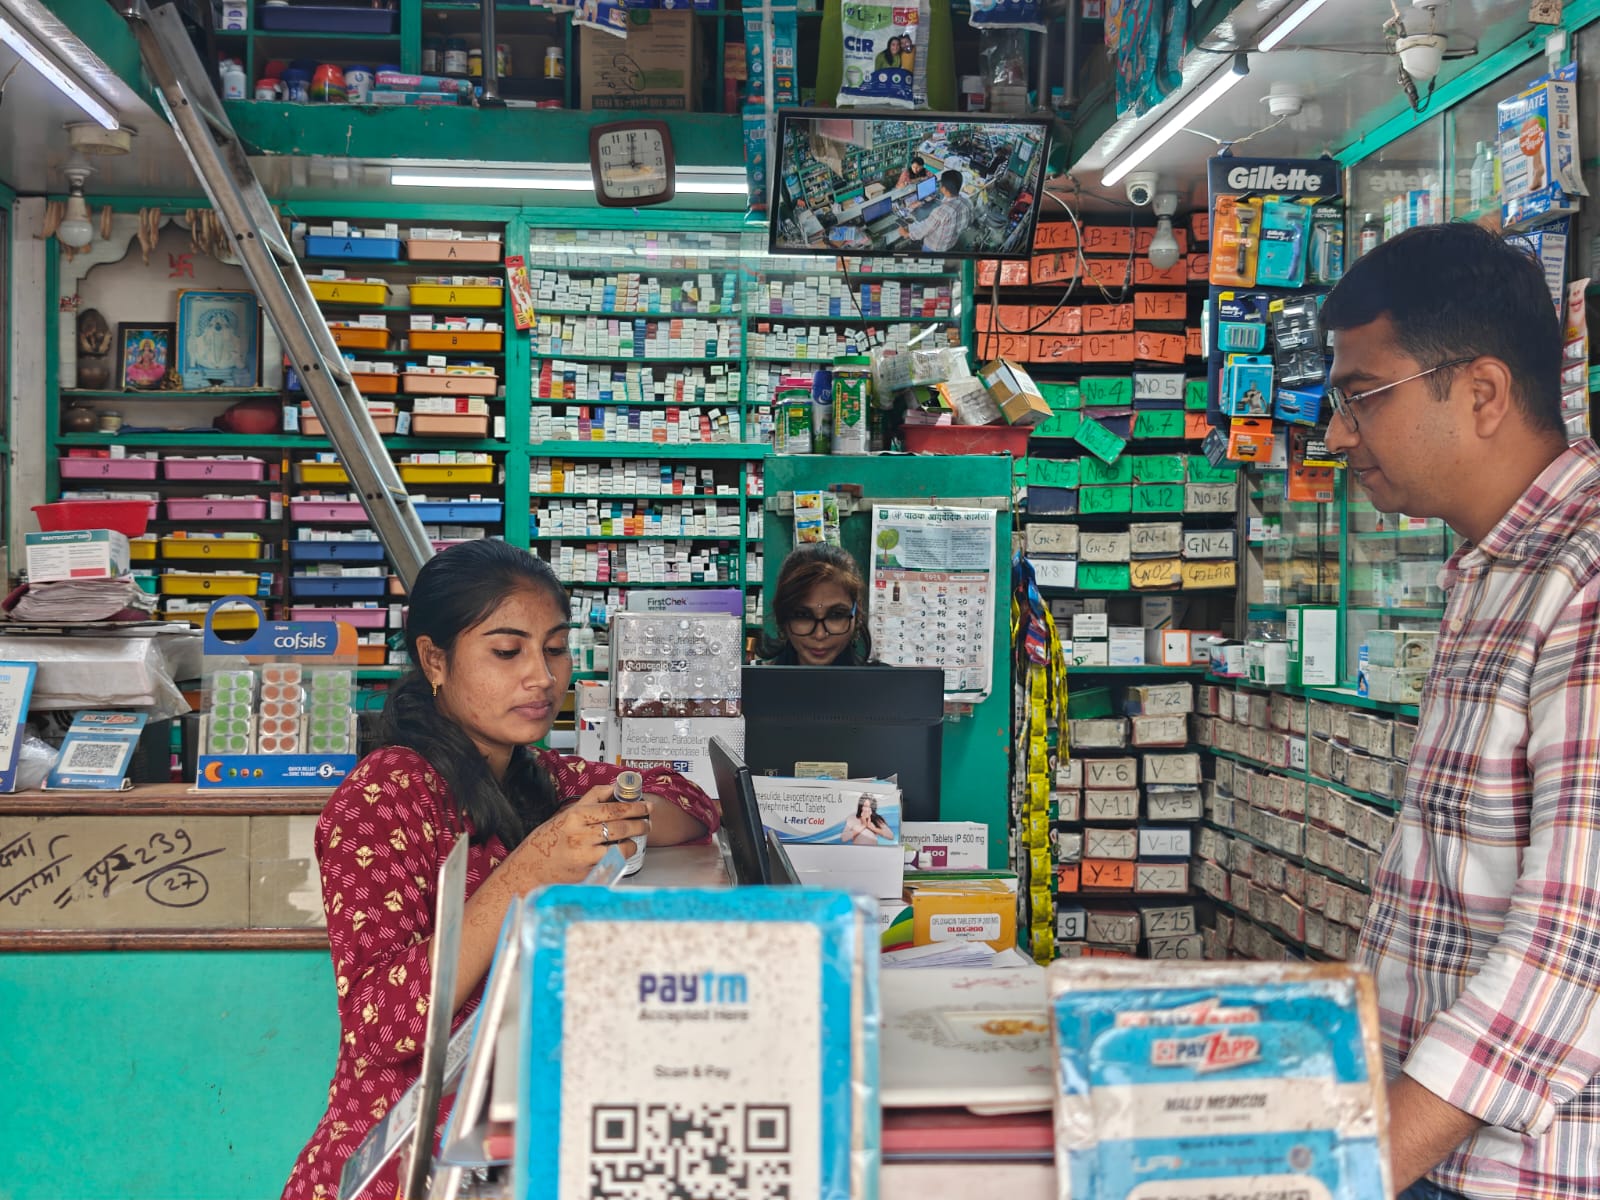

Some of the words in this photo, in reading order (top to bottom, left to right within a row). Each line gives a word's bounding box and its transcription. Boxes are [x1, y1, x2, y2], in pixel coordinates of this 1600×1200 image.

[601, 145, 611, 155] 10
[654, 141, 661, 151] 2
[655, 157, 662, 166] 3
[1227, 165, 1322, 192] Gillette
[343, 242, 353, 253] A
[448, 247, 457, 258] A
[449, 290, 457, 302] A
[1144, 295, 1172, 315] N-1
[647, 597, 687, 606] FirstChek
[274, 632, 326, 650] cofsils
[673, 762, 688, 772] SP
[805, 802, 826, 814] Tablets
[808, 817, 825, 825] Cold
[932, 833, 953, 844] Tablets
[954, 833, 962, 843] IP
[962, 834, 974, 844] 500
[975, 836, 985, 846] mg
[1090, 865, 1124, 883] Y-1
[164, 872, 198, 891] 27
[638, 969, 748, 1004] paytm
[638, 1008, 710, 1025] Accepted
[713, 1008, 749, 1021] Here
[654, 1064, 690, 1079] Scan
[694, 1065, 702, 1079] &
[705, 1065, 731, 1080] Pay
